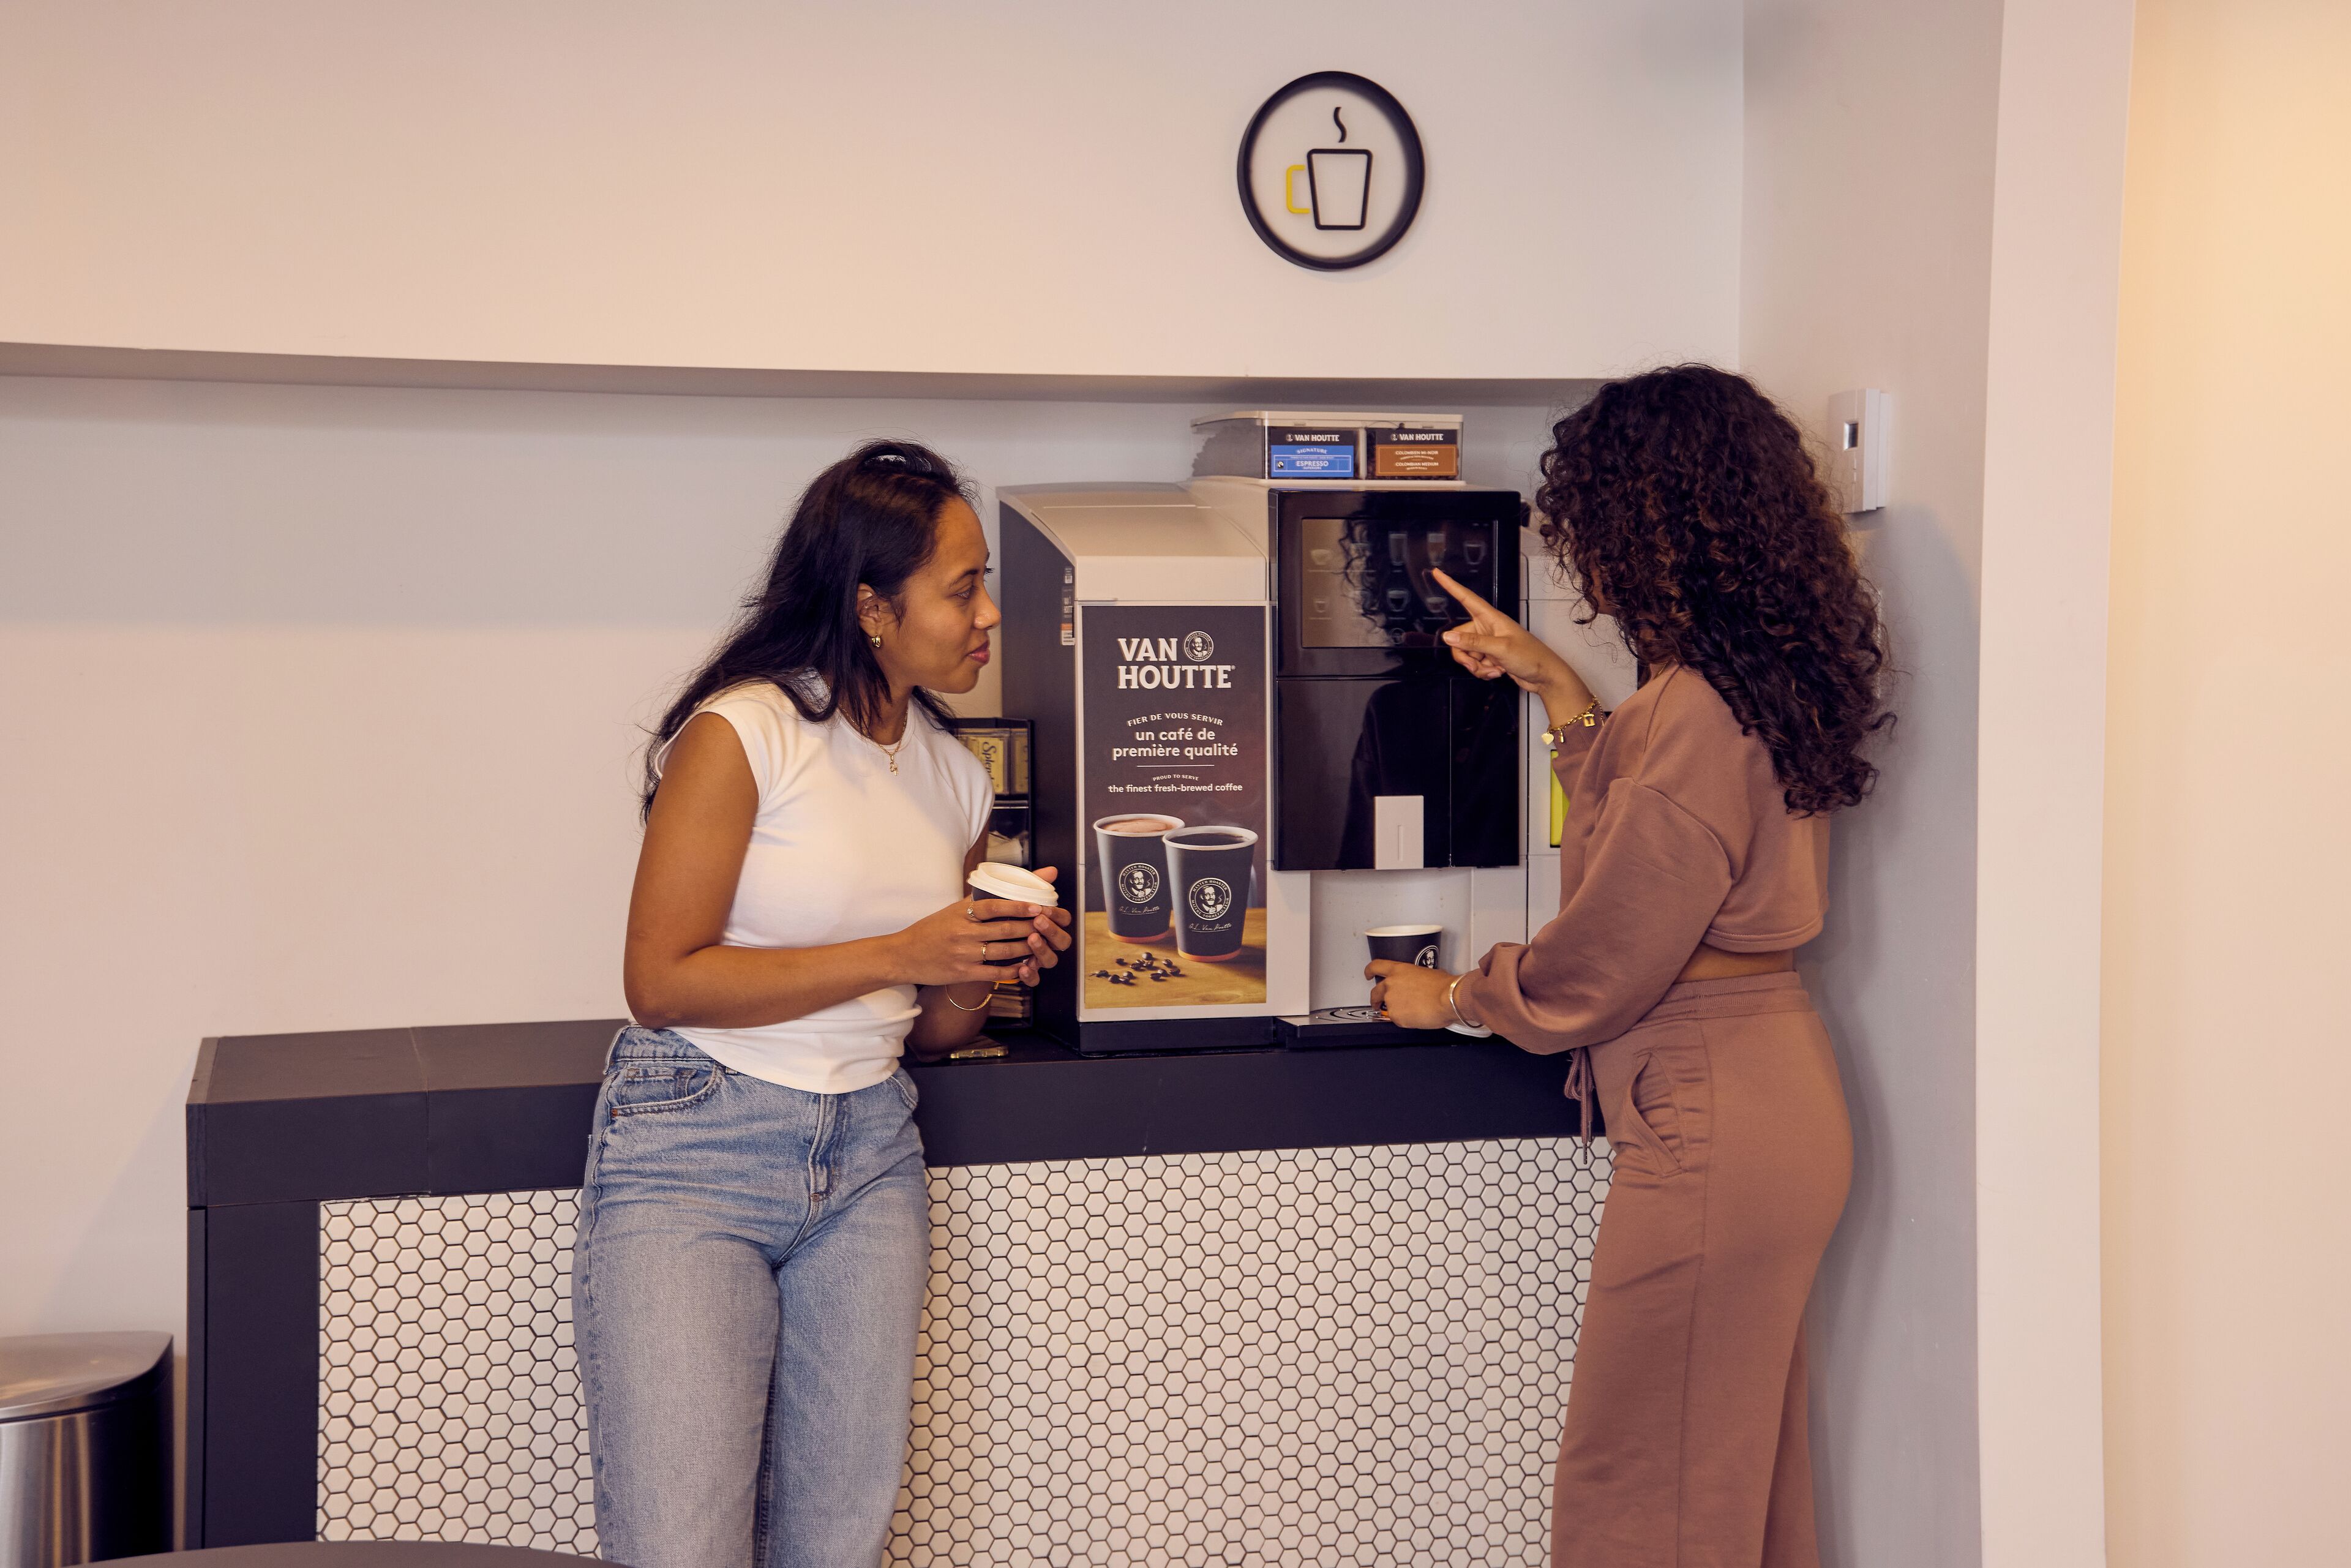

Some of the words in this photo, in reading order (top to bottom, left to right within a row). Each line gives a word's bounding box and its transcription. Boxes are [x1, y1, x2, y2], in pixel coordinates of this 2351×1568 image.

[1117, 638, 1177, 661] VAN
[1127, 716, 1147, 727] FIER
[1191, 713, 1223, 726] SERVIR
[1136, 730, 1155, 740] un
[1160, 728, 1193, 740] café
[1197, 729, 1215, 740] de
[1112, 745, 1180, 760] première
[1185, 743, 1238, 759] qualité
[1122, 865, 1137, 876] MASTER
[1138, 865, 1155, 876] ROASTER
[1193, 880, 1208, 892] MASTER
[1209, 880, 1228, 891] ROASTER
